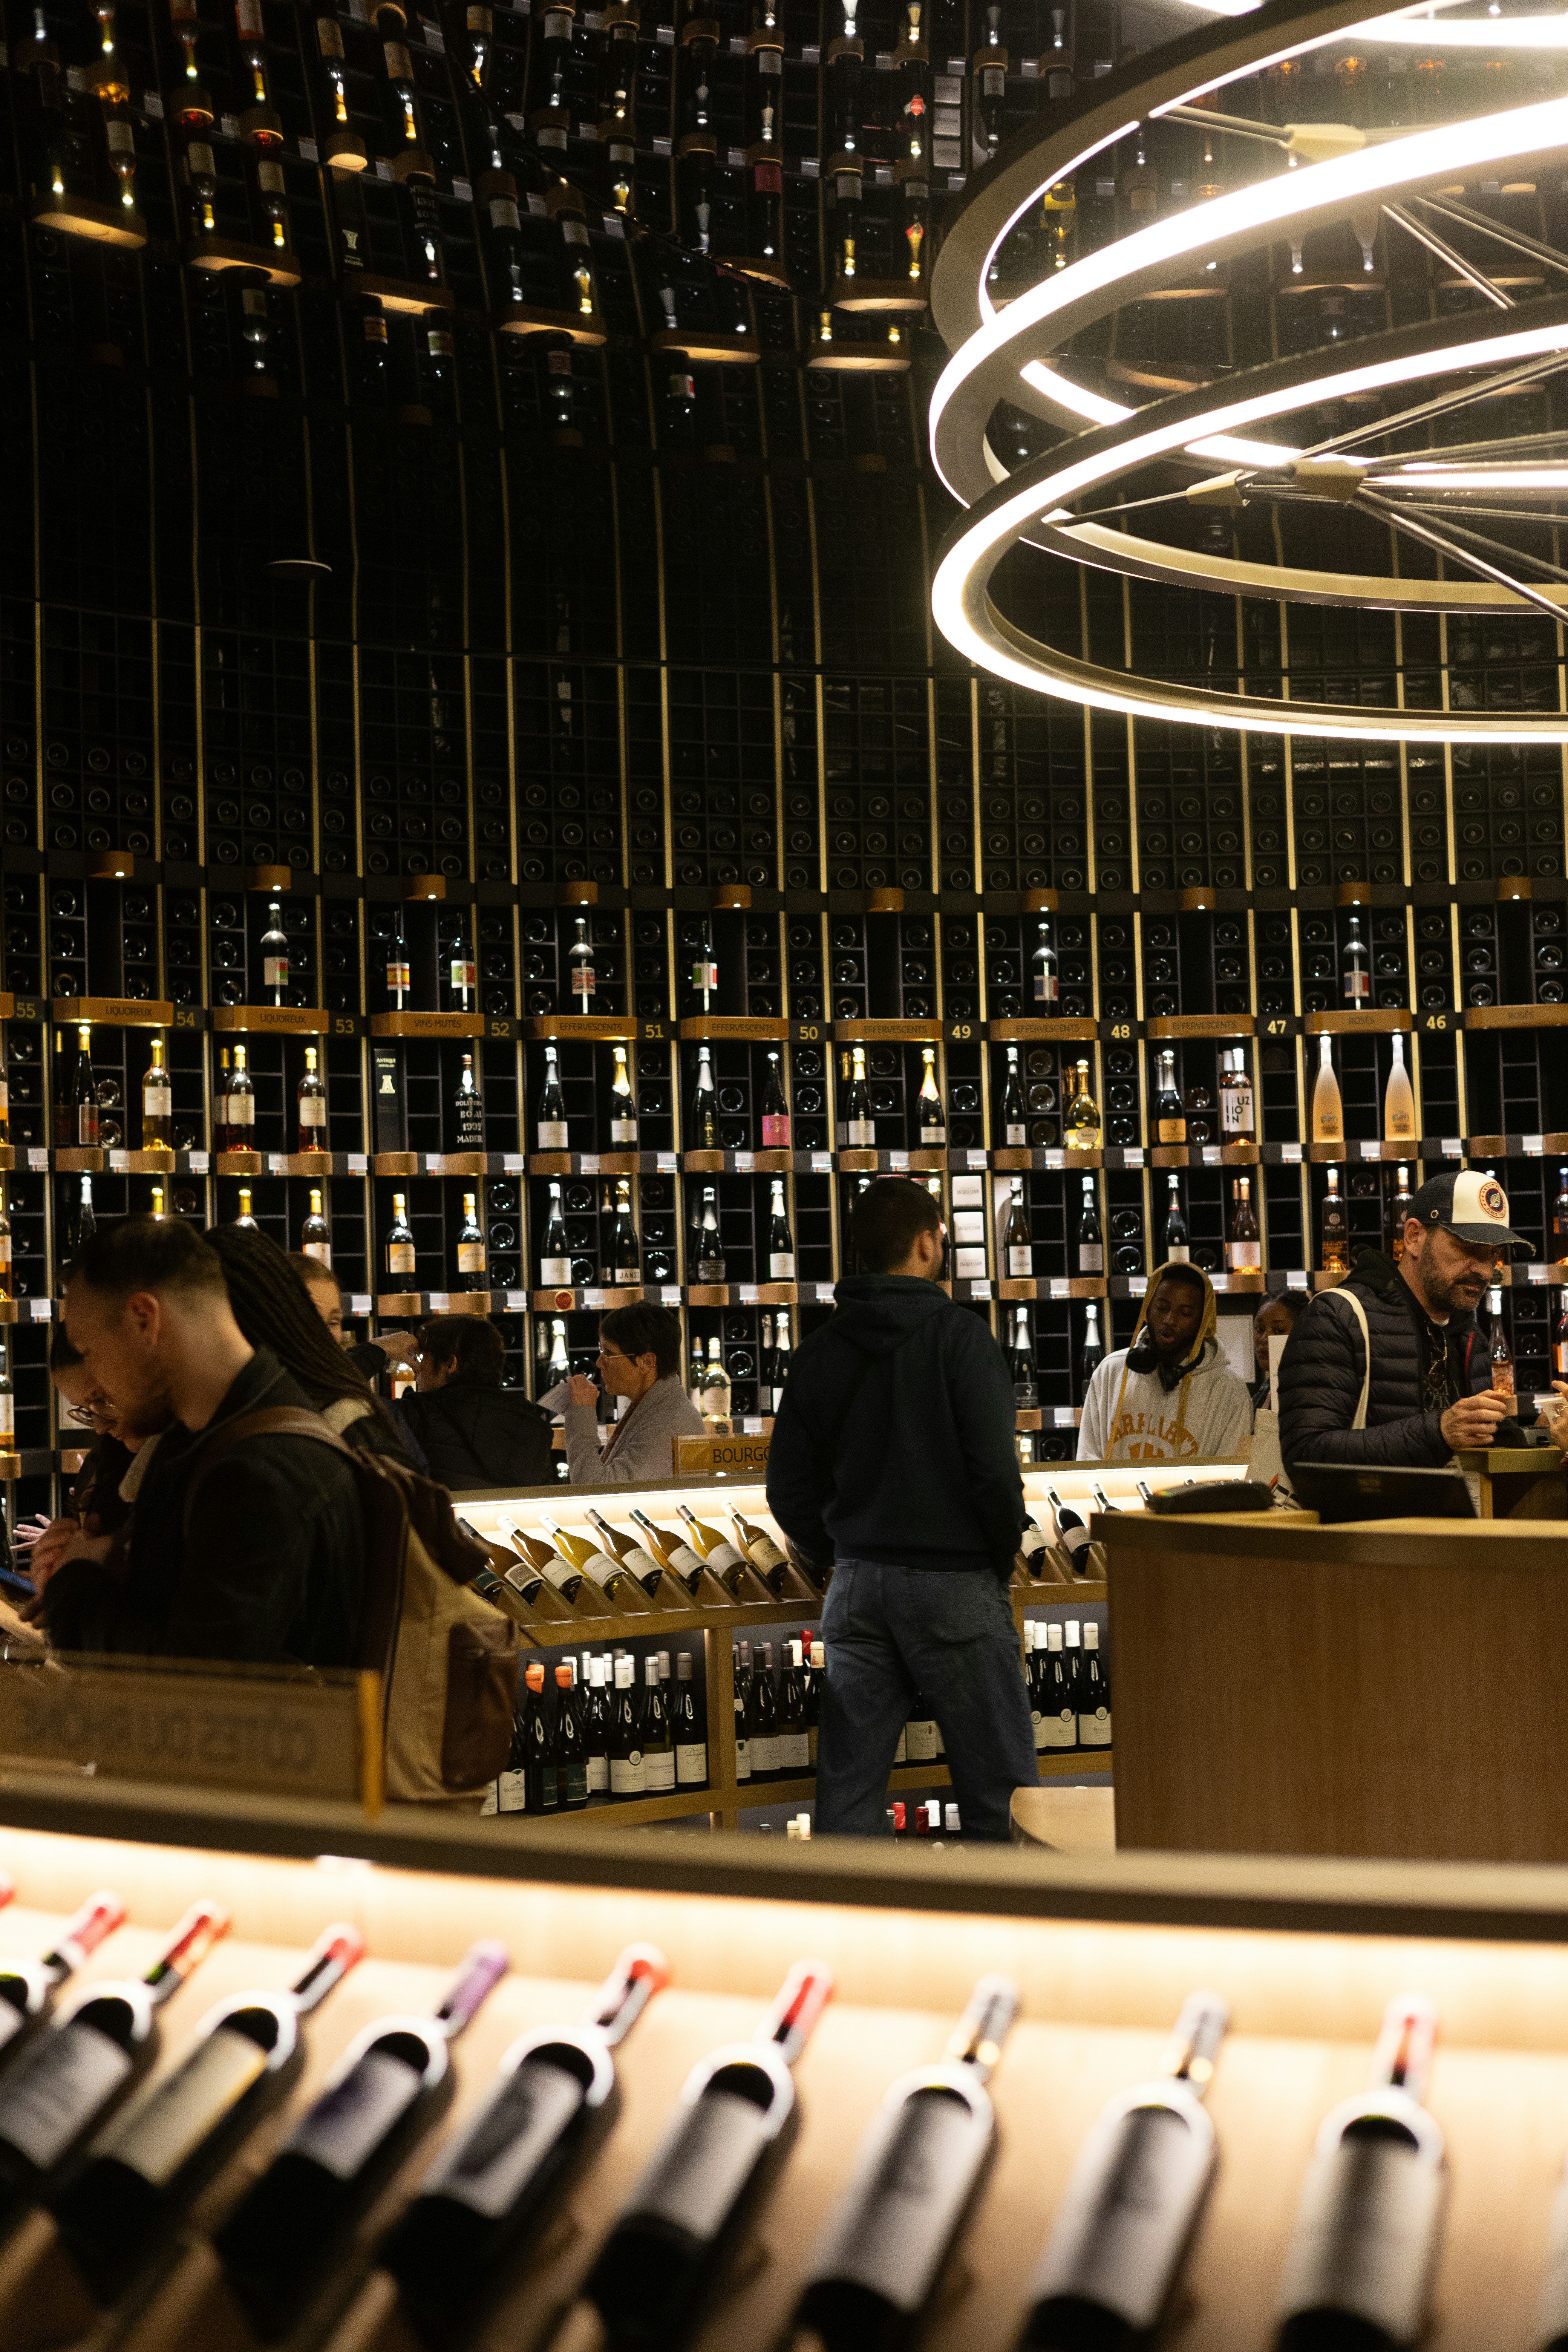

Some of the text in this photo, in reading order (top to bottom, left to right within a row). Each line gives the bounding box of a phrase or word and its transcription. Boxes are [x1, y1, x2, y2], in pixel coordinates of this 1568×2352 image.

[16, 1002, 36, 1019] 55
[106, 1006, 152, 1017] LIQUOREUX
[1508, 1009, 1535, 1020] ROSÉS
[176, 1011, 195, 1027] 54
[260, 1013, 306, 1024] LIQUOREUX
[414, 1018, 462, 1029] VINS MUTÉS
[1172, 1020, 1237, 1031] EFFERVESCENTS
[1349, 1015, 1375, 1025] ROSÉS
[1427, 1015, 1447, 1030] 46
[335, 1018, 354, 1034] 53
[491, 1022, 509, 1037] 52
[559, 1021, 623, 1032] EFFERVESCENTS
[645, 1024, 664, 1038] 51
[712, 1022, 775, 1032] EFFERVESCENTS
[799, 1026, 818, 1040] 50
[864, 1024, 927, 1035] EFFERVESCENTS
[951, 1025, 971, 1039] 49
[1015, 1023, 1080, 1033] EFFERVESCENTS
[1111, 1024, 1130, 1038] 48
[1268, 1020, 1286, 1034] 47
[379, 1075, 395, 1093] A
